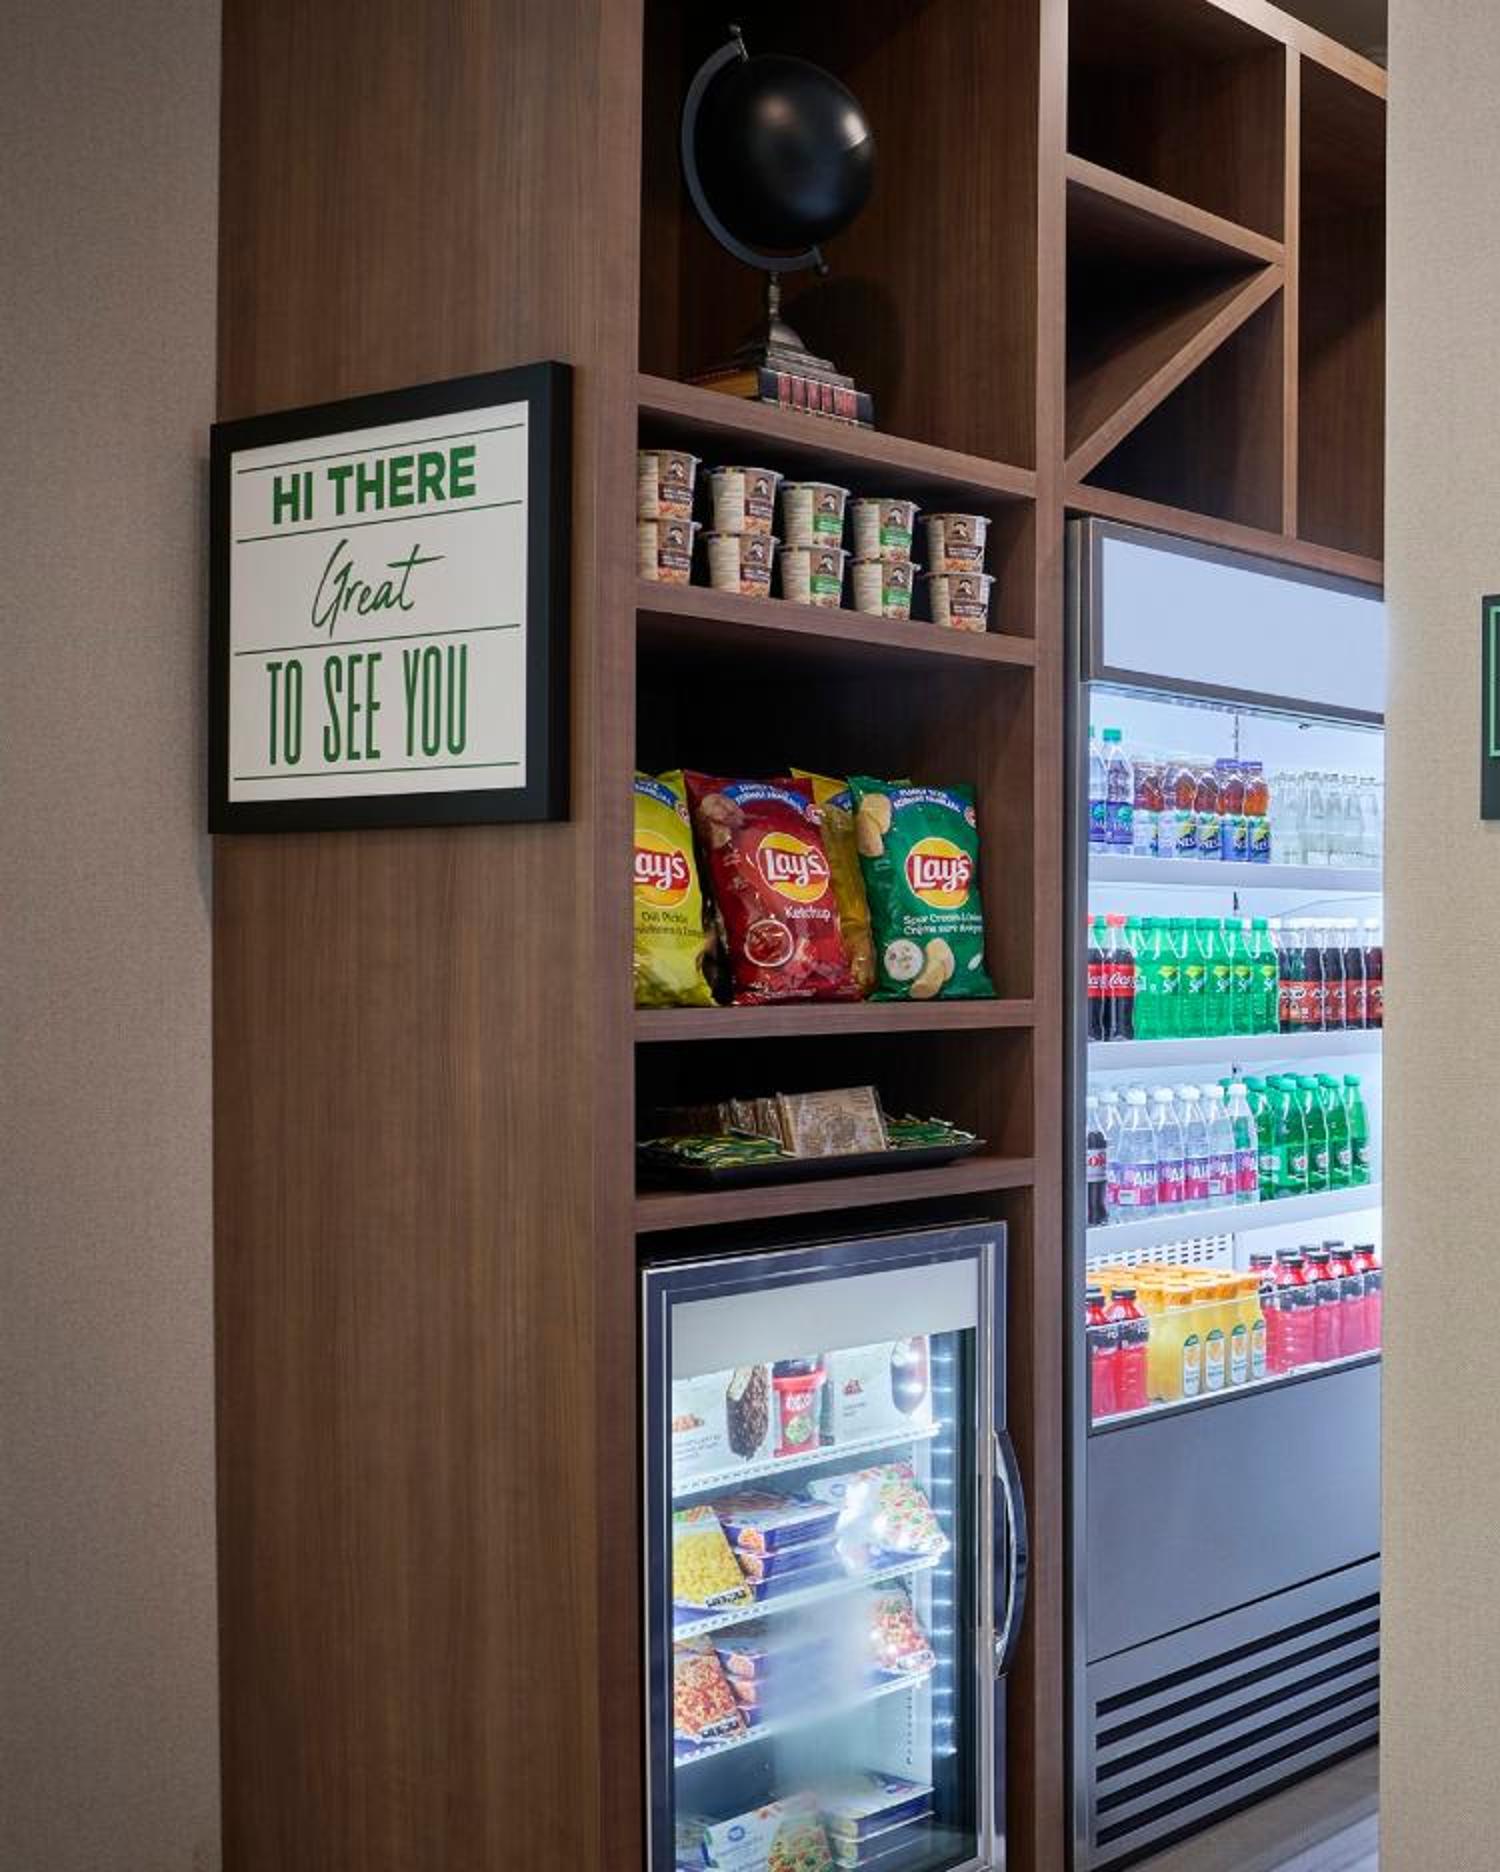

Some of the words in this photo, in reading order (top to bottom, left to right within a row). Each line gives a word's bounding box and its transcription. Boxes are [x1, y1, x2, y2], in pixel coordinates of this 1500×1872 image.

[272, 471, 313, 525] HI
[328, 445, 477, 516] THERE
[311, 538, 446, 639] Great
[266, 659, 301, 766] TO
[323, 653, 383, 762] SEE
[402, 643, 468, 757] YOU
[634, 851, 685, 890] ay's
